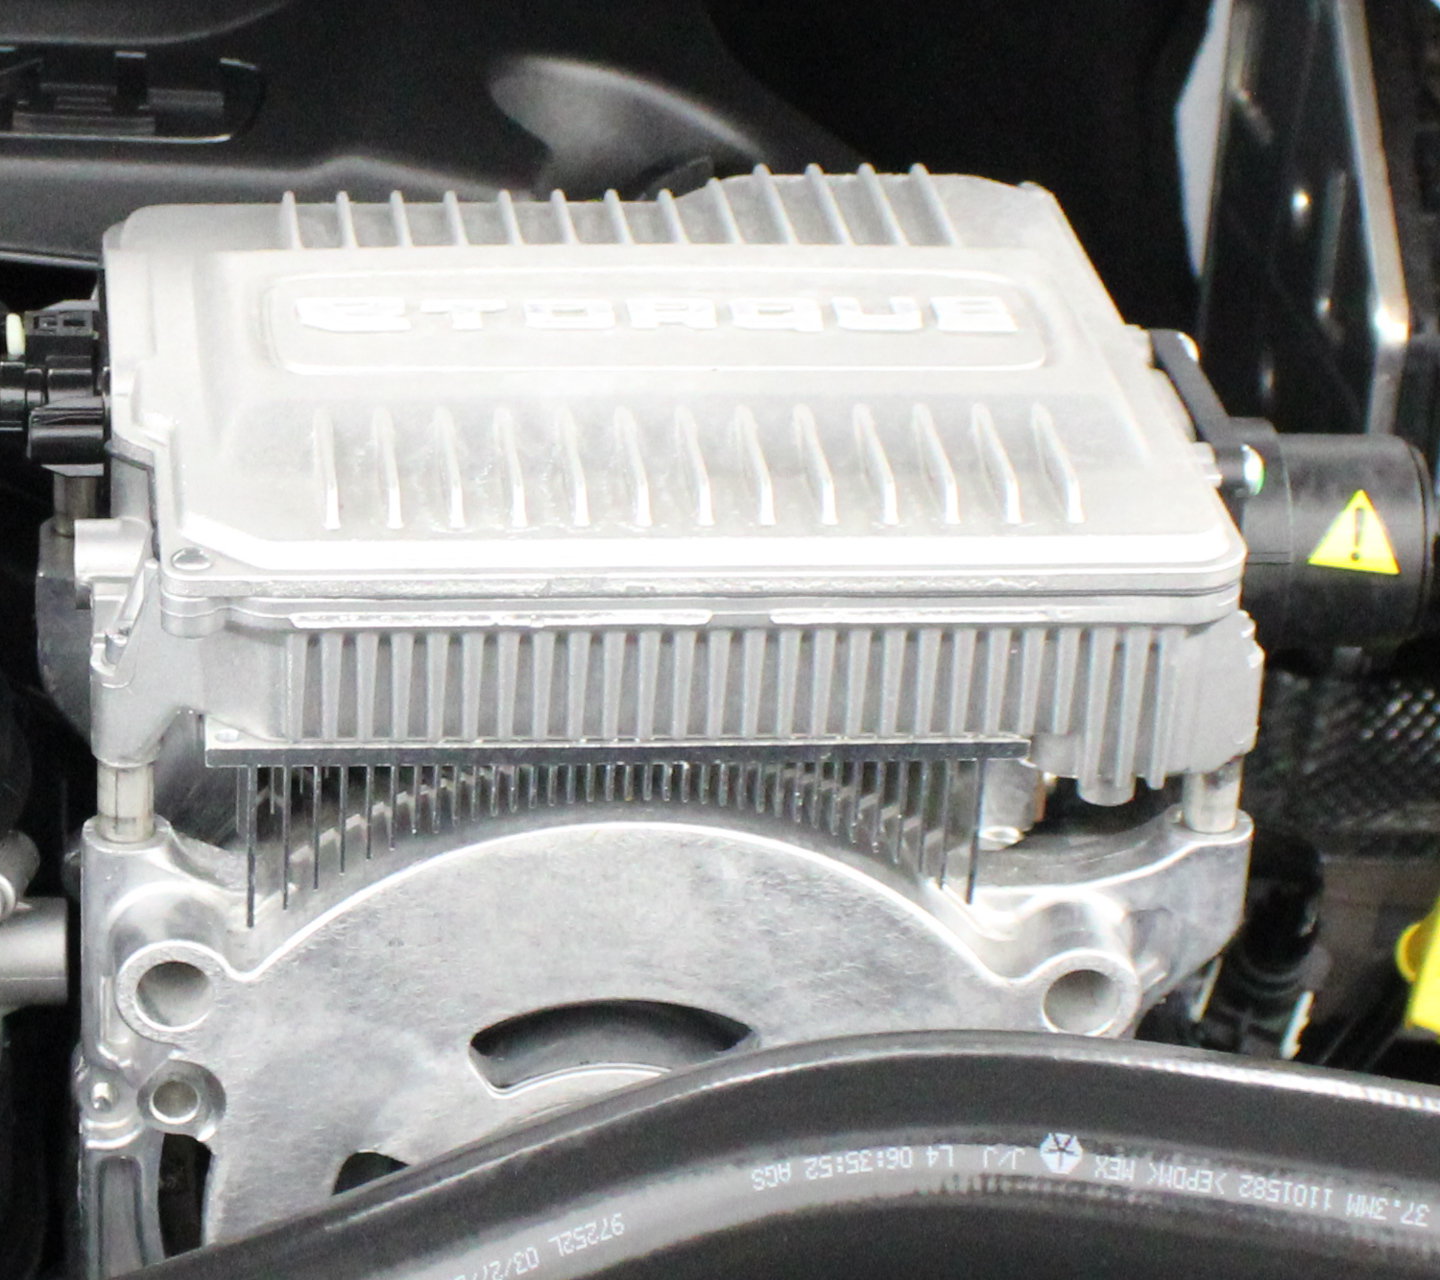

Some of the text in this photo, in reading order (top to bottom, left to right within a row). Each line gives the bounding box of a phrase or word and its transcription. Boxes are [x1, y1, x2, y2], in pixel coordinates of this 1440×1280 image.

[804, 1147, 913, 1179] 06:35:52
[926, 1146, 954, 1168] L4
[1094, 1155, 1136, 1184] MEX
[751, 1163, 792, 1190] AGS
[1239, 1174, 1335, 1211] 1101582
[1347, 1193, 1430, 1226] 37.3MM
[547, 1211, 625, 1258] 97252L
